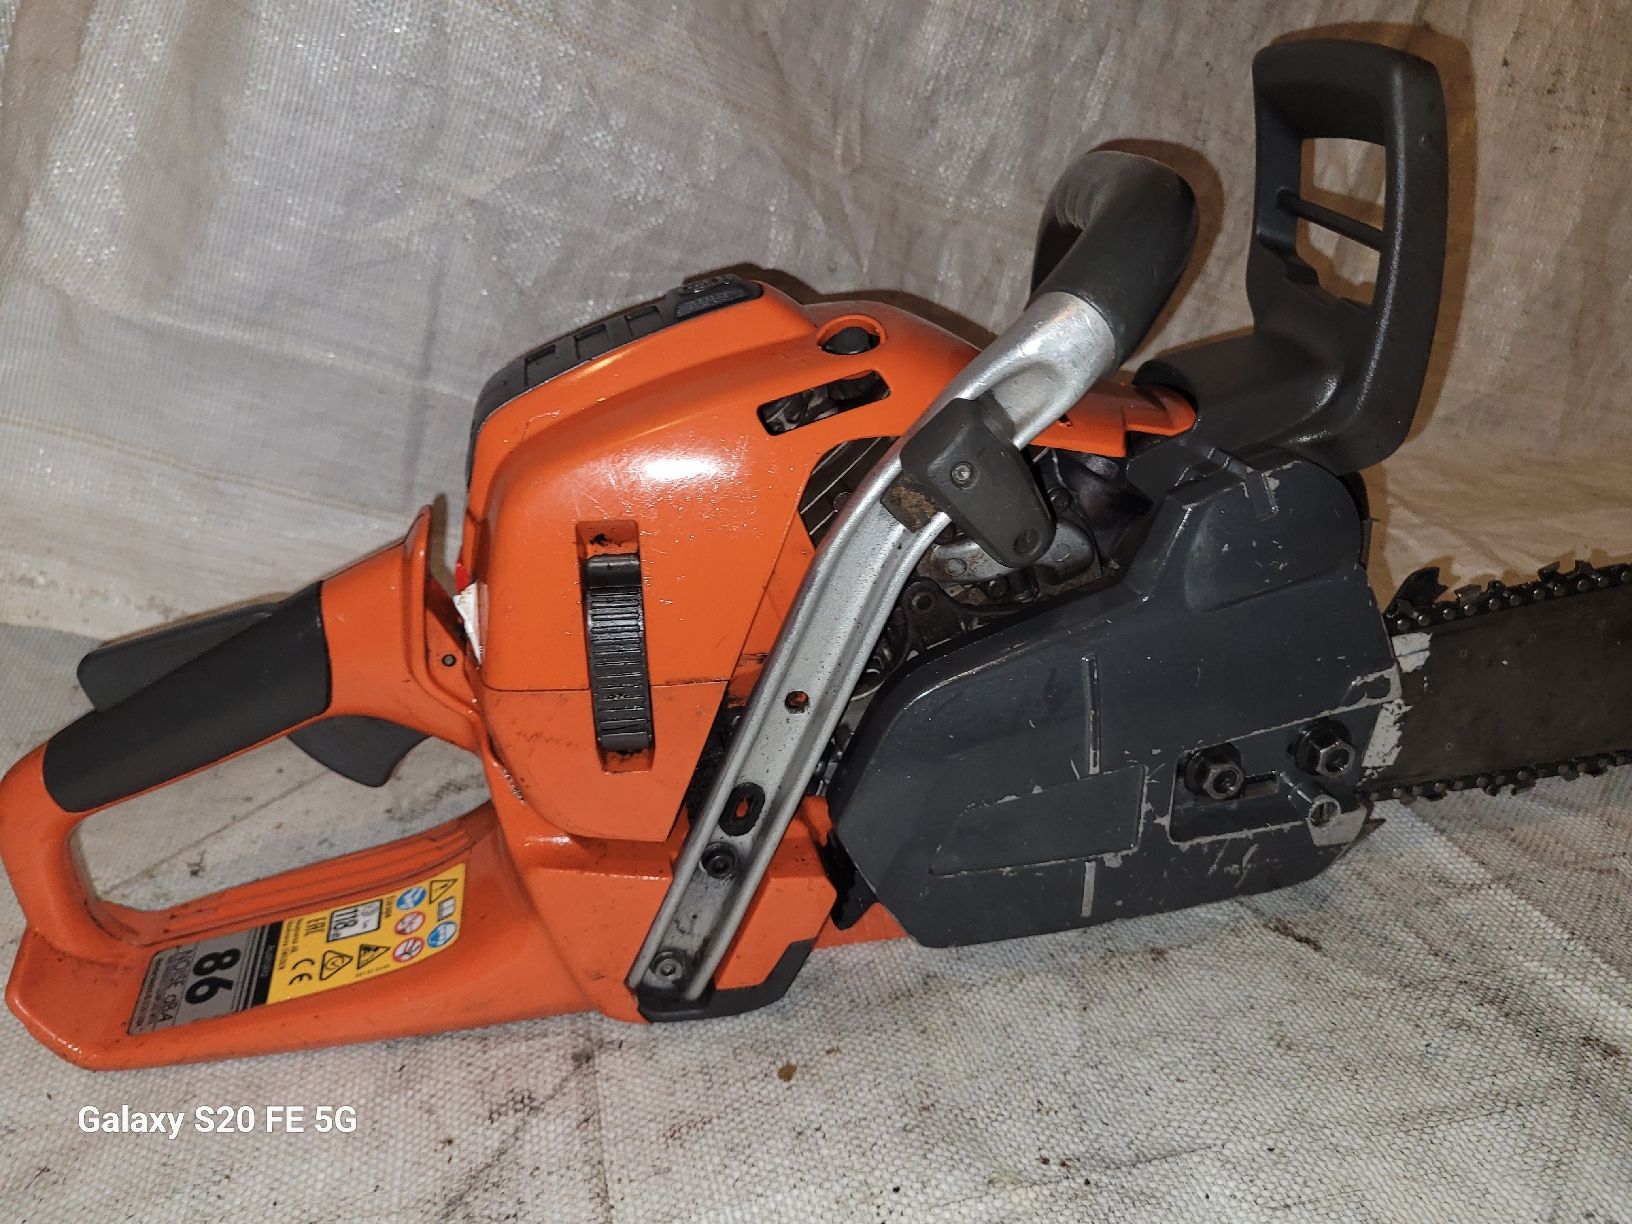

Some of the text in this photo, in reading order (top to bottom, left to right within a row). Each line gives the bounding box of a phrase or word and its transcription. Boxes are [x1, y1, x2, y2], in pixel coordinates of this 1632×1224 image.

[333, 909, 359, 930] 118
[185, 947, 241, 1005] 86
[289, 958, 315, 986] CE
